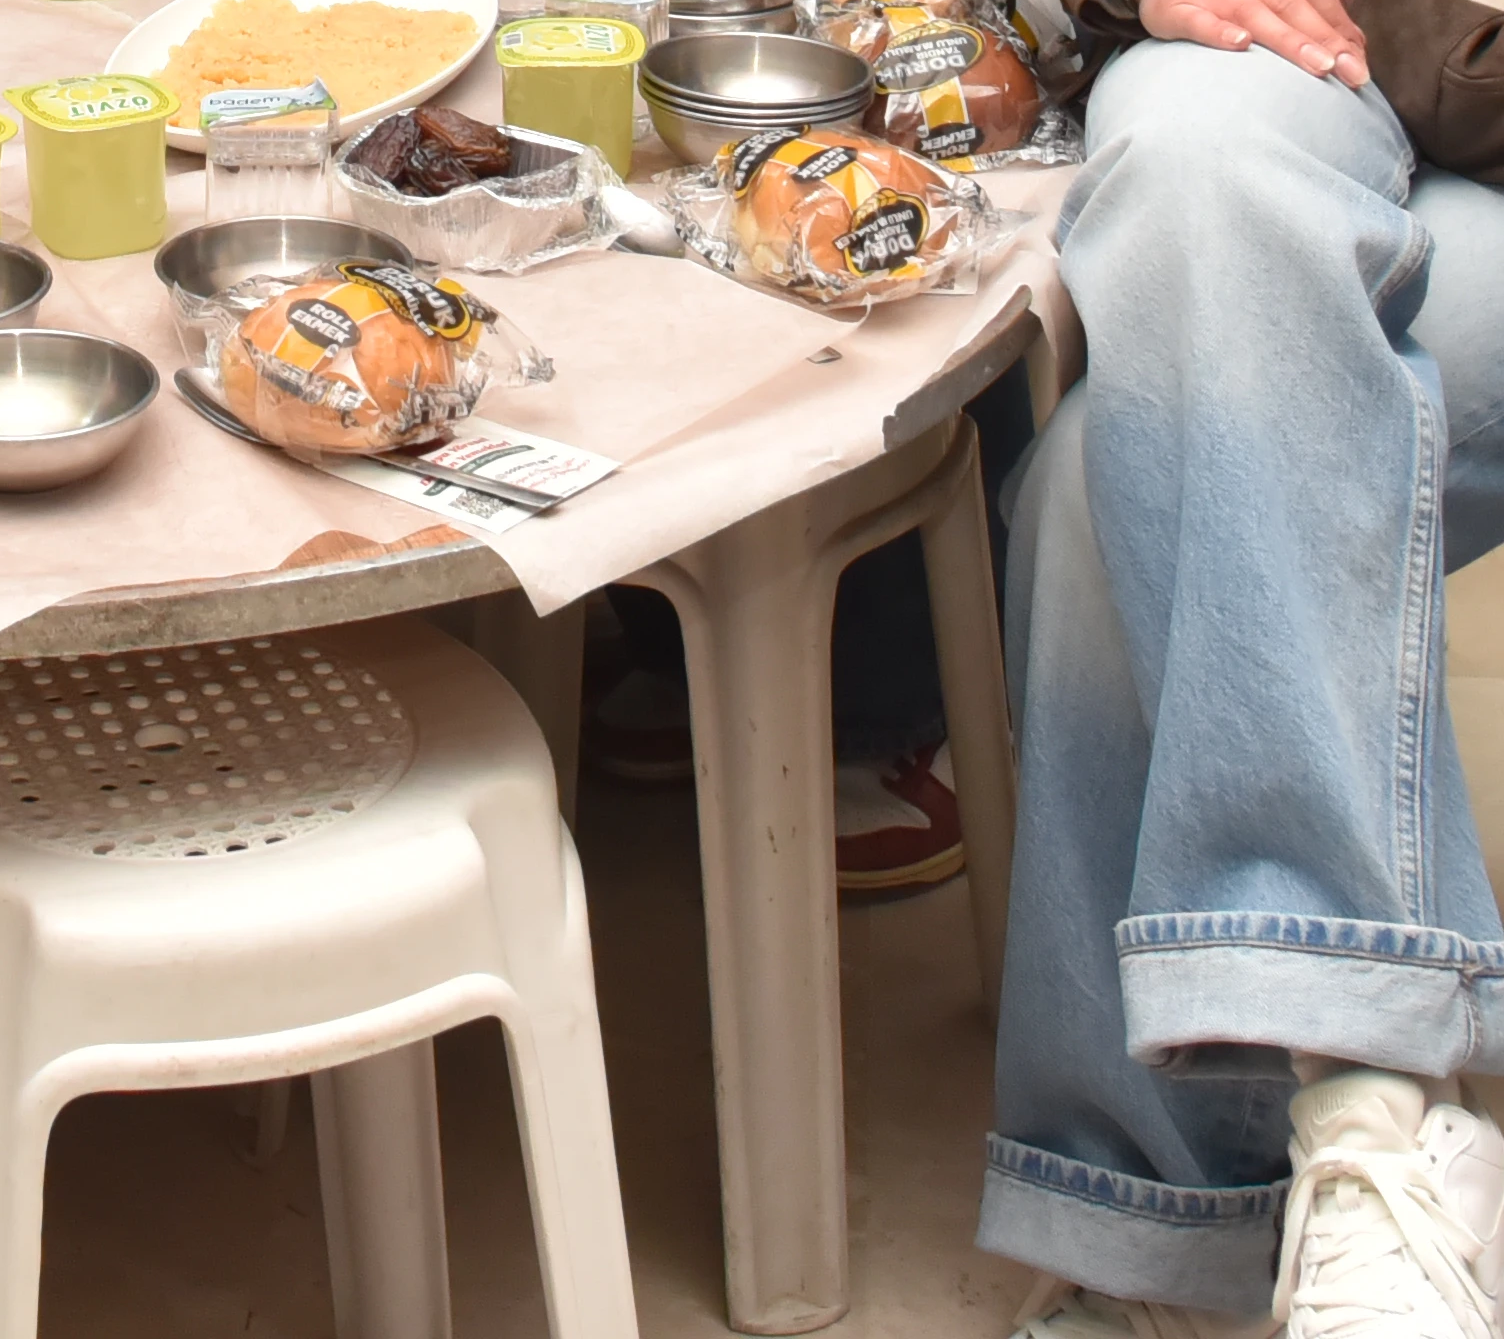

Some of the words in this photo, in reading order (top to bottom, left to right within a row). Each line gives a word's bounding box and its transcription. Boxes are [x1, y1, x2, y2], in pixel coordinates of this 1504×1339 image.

[915, 46, 965, 60] TANDIR
[936, 36, 969, 49] UNLU
[69, 95, 149, 119] ÖZVİT
[209, 96, 282, 106] badem
[920, 127, 977, 151] EKMEK
[927, 142, 970, 160] ROLL
[383, 265, 456, 327] DORUK
[291, 308, 352, 344] EKMEK
[308, 302, 353, 331] ROLL
